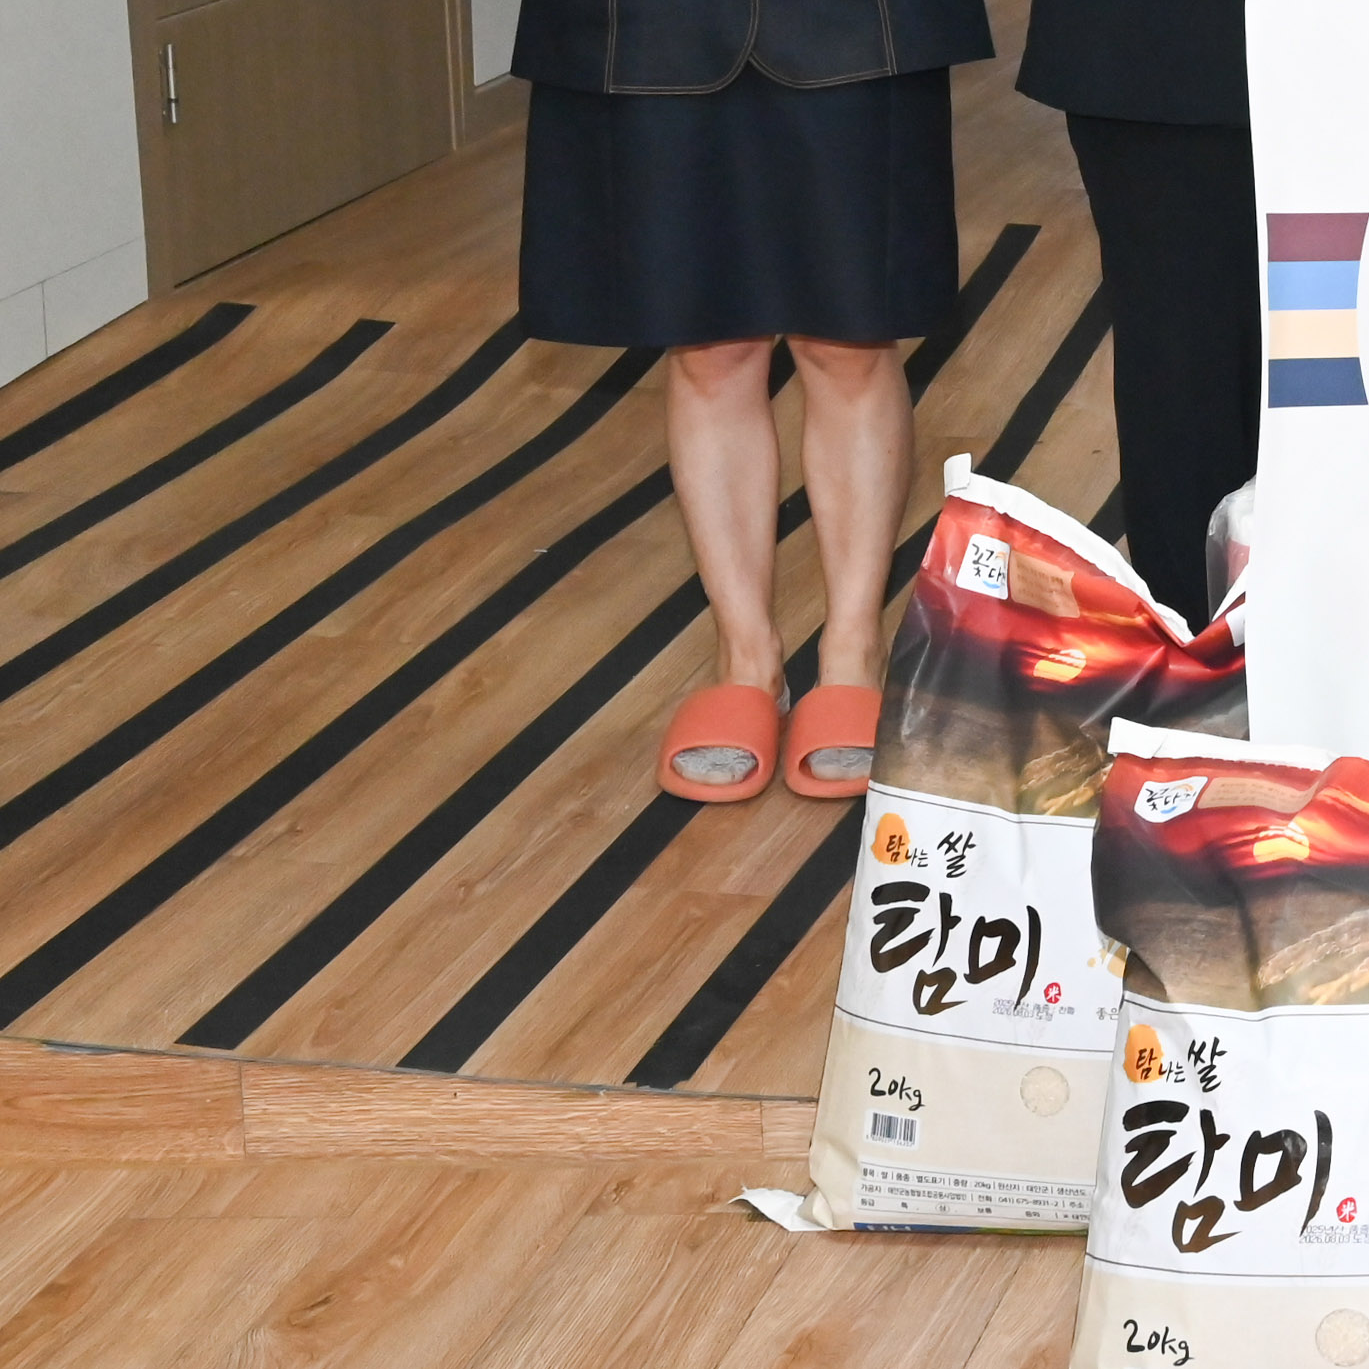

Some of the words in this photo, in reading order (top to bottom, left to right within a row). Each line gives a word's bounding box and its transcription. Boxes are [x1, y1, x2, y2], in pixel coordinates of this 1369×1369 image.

[937, 831, 976, 879] 쌀
[870, 881, 1042, 1016] 탐미
[868, 1067, 925, 1111] 20kg
[1187, 1036, 1228, 1093] 쌀
[1121, 1100, 1334, 1254] 탐미
[1123, 1319, 1195, 1367] 20kg
